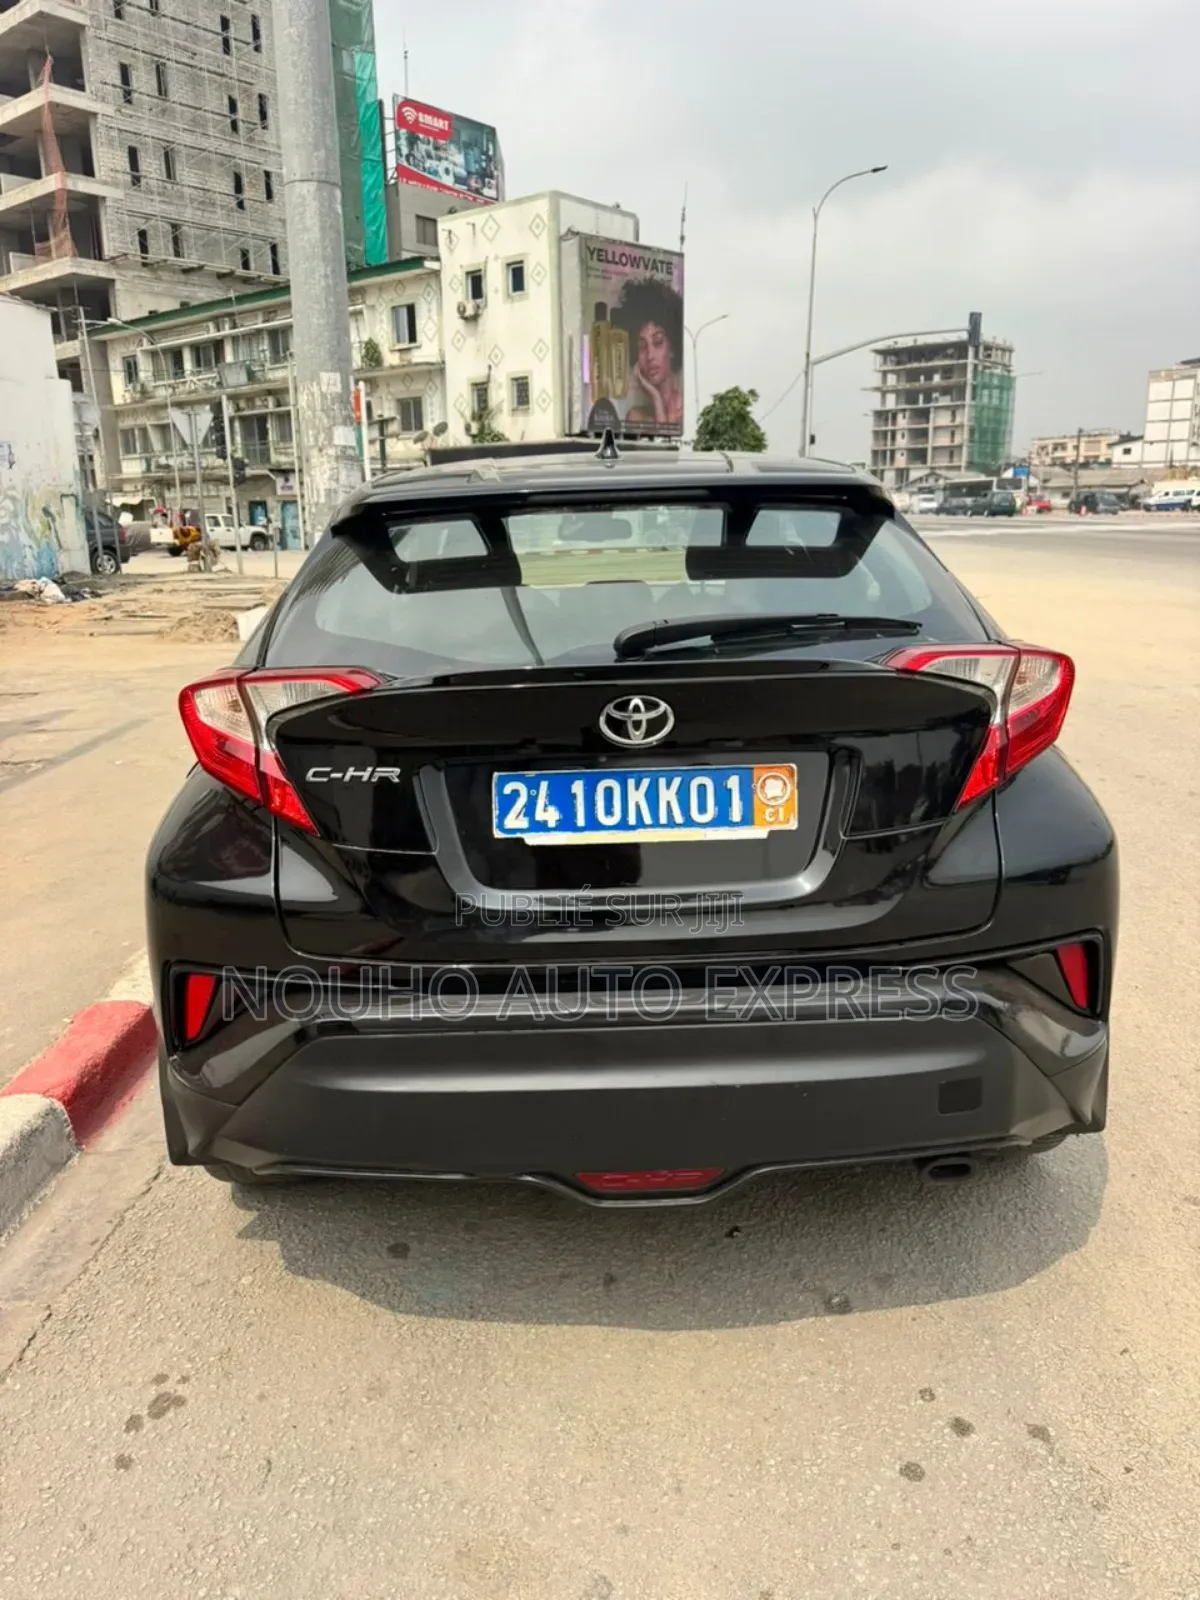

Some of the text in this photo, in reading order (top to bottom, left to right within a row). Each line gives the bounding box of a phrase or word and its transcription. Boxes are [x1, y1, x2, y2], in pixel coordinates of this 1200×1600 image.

[586, 245, 673, 275] YELLOWVATE
[305, 766, 401, 783] C-HR
[503, 774, 743, 829] 2410KK01
